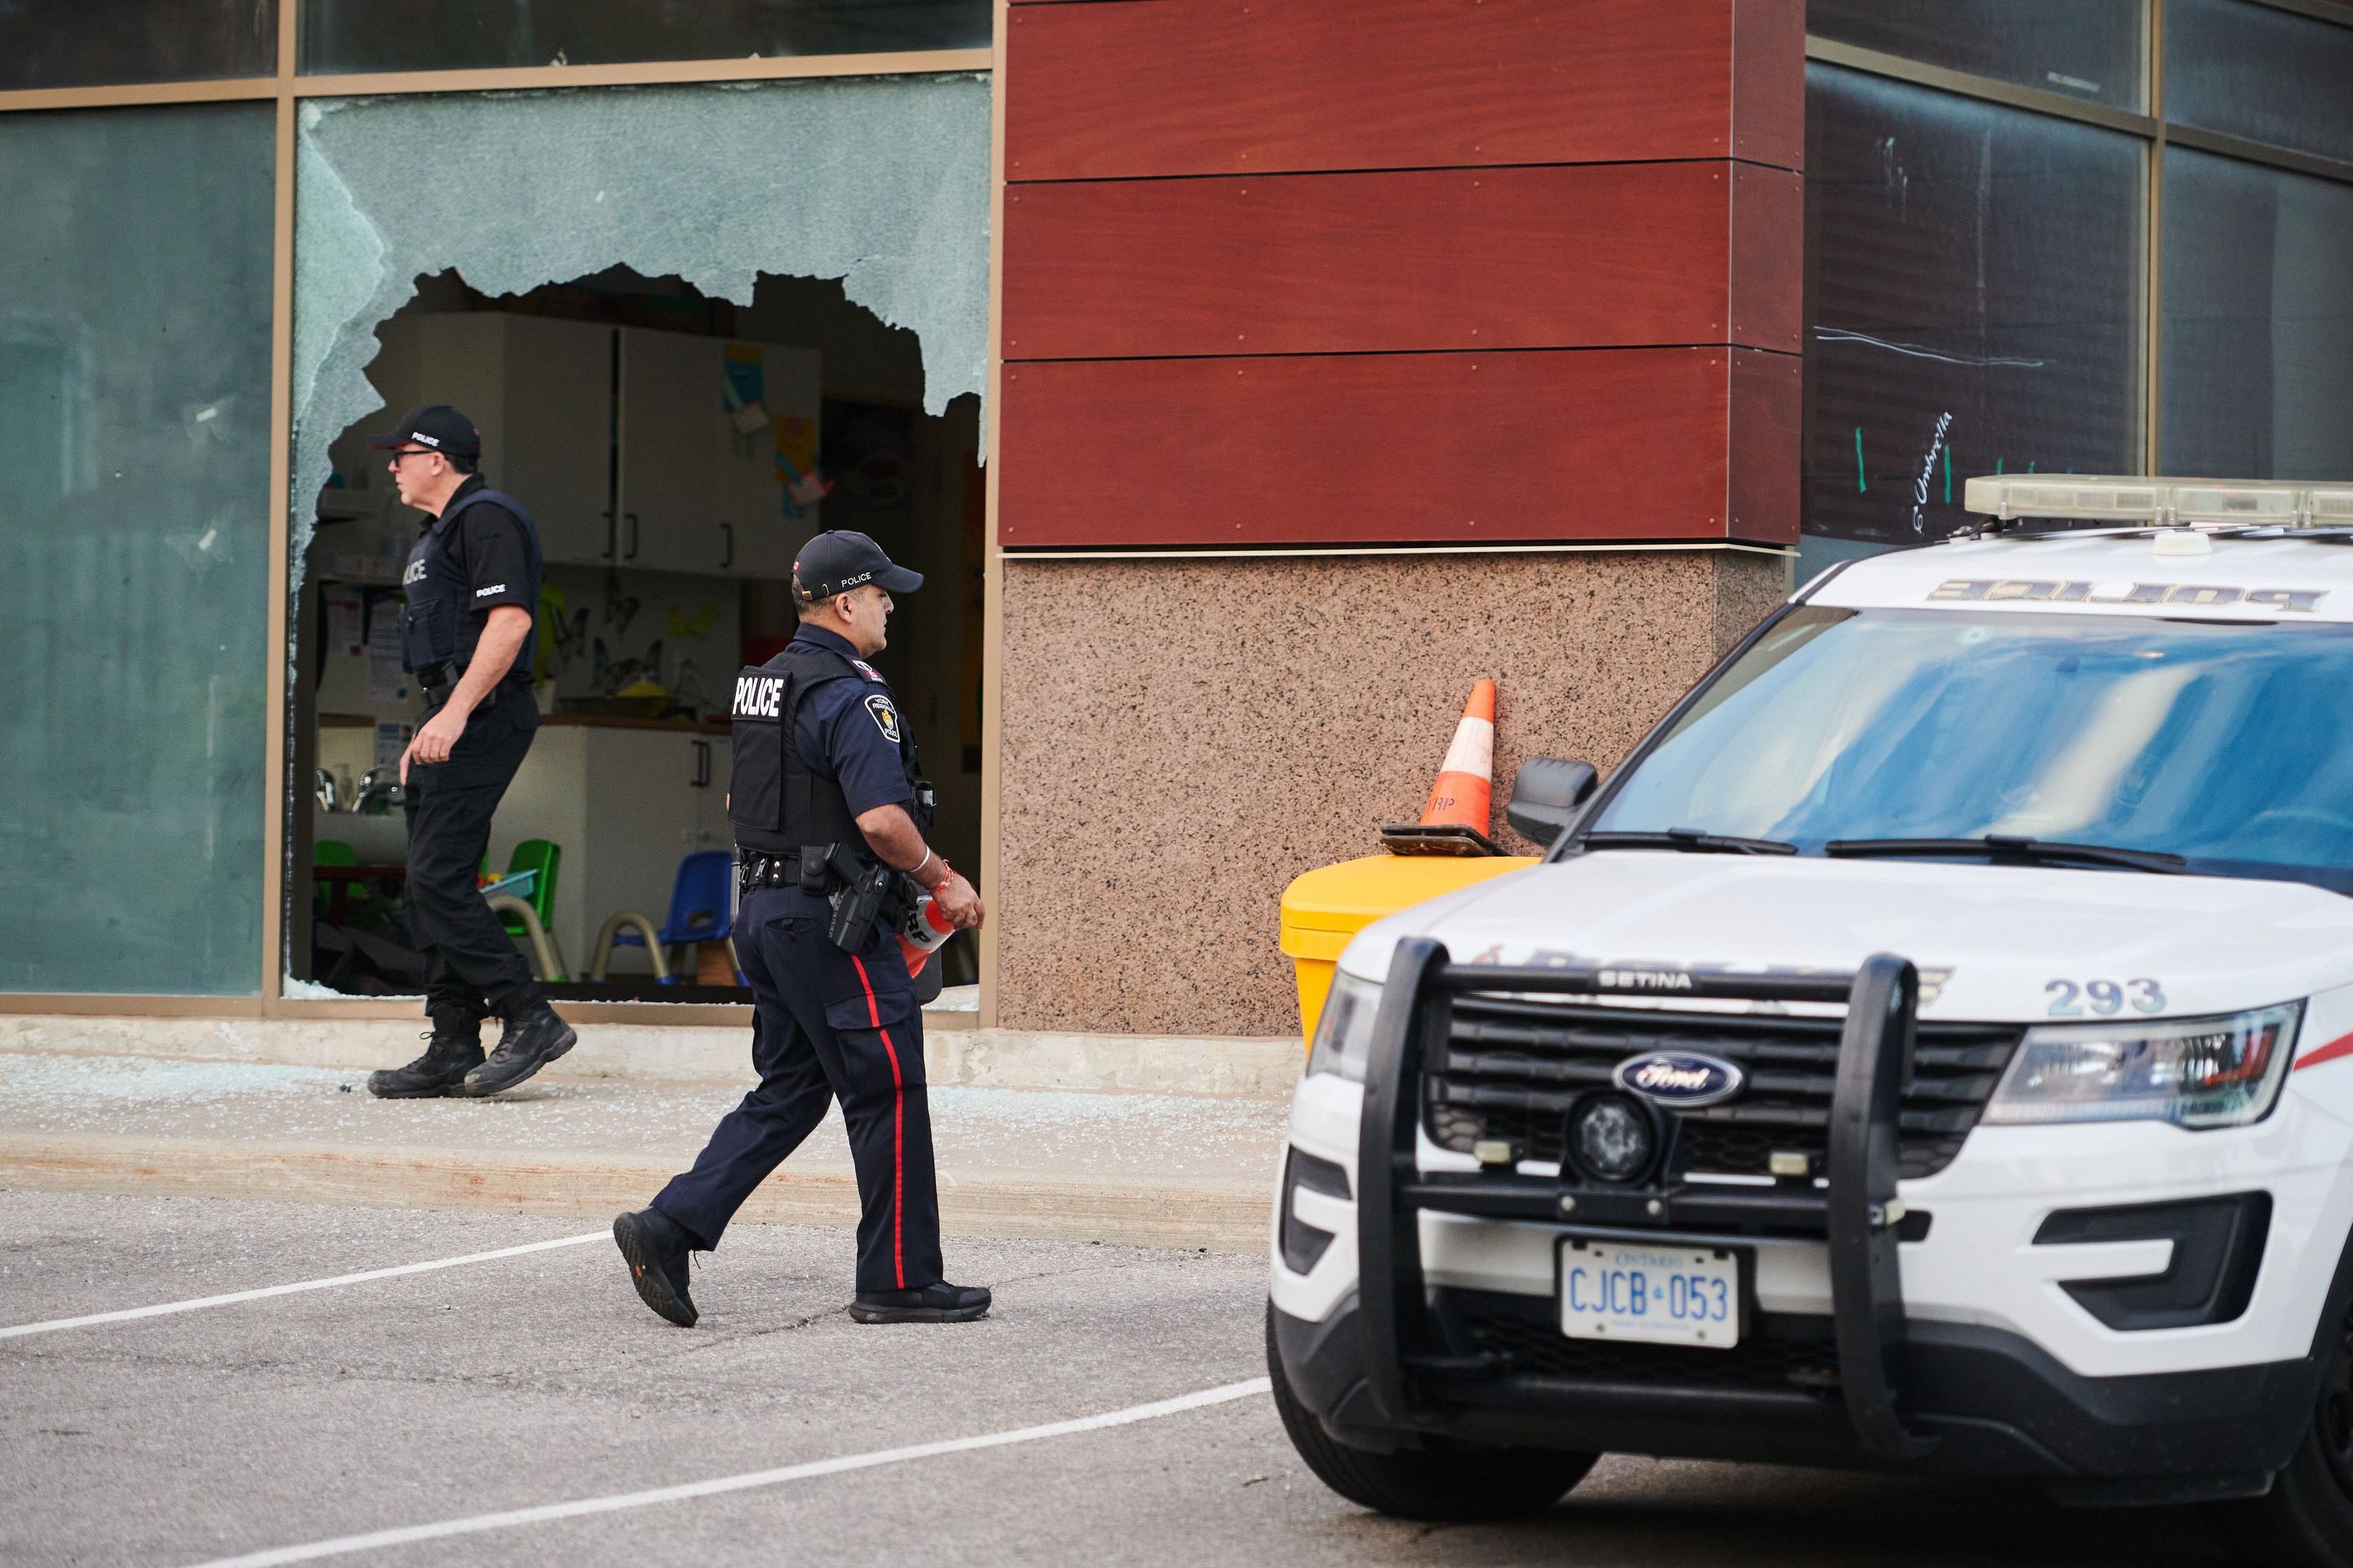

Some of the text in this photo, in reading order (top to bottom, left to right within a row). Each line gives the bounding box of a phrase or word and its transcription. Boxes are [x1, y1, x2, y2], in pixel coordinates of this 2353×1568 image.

[412, 431, 440, 447] POLICE
[403, 558, 427, 586] LICE
[841, 572, 872, 588] POLICE
[476, 584, 506, 598] POLICE
[733, 677, 784, 717] POLICE
[1598, 970, 1692, 989] SETINA
[2045, 978, 2168, 1016] 293
[1635, 1058, 1711, 1089] Ford
[1615, 1251, 1684, 1267] ONTARIO
[1571, 1267, 1727, 1321] CJCB 053
